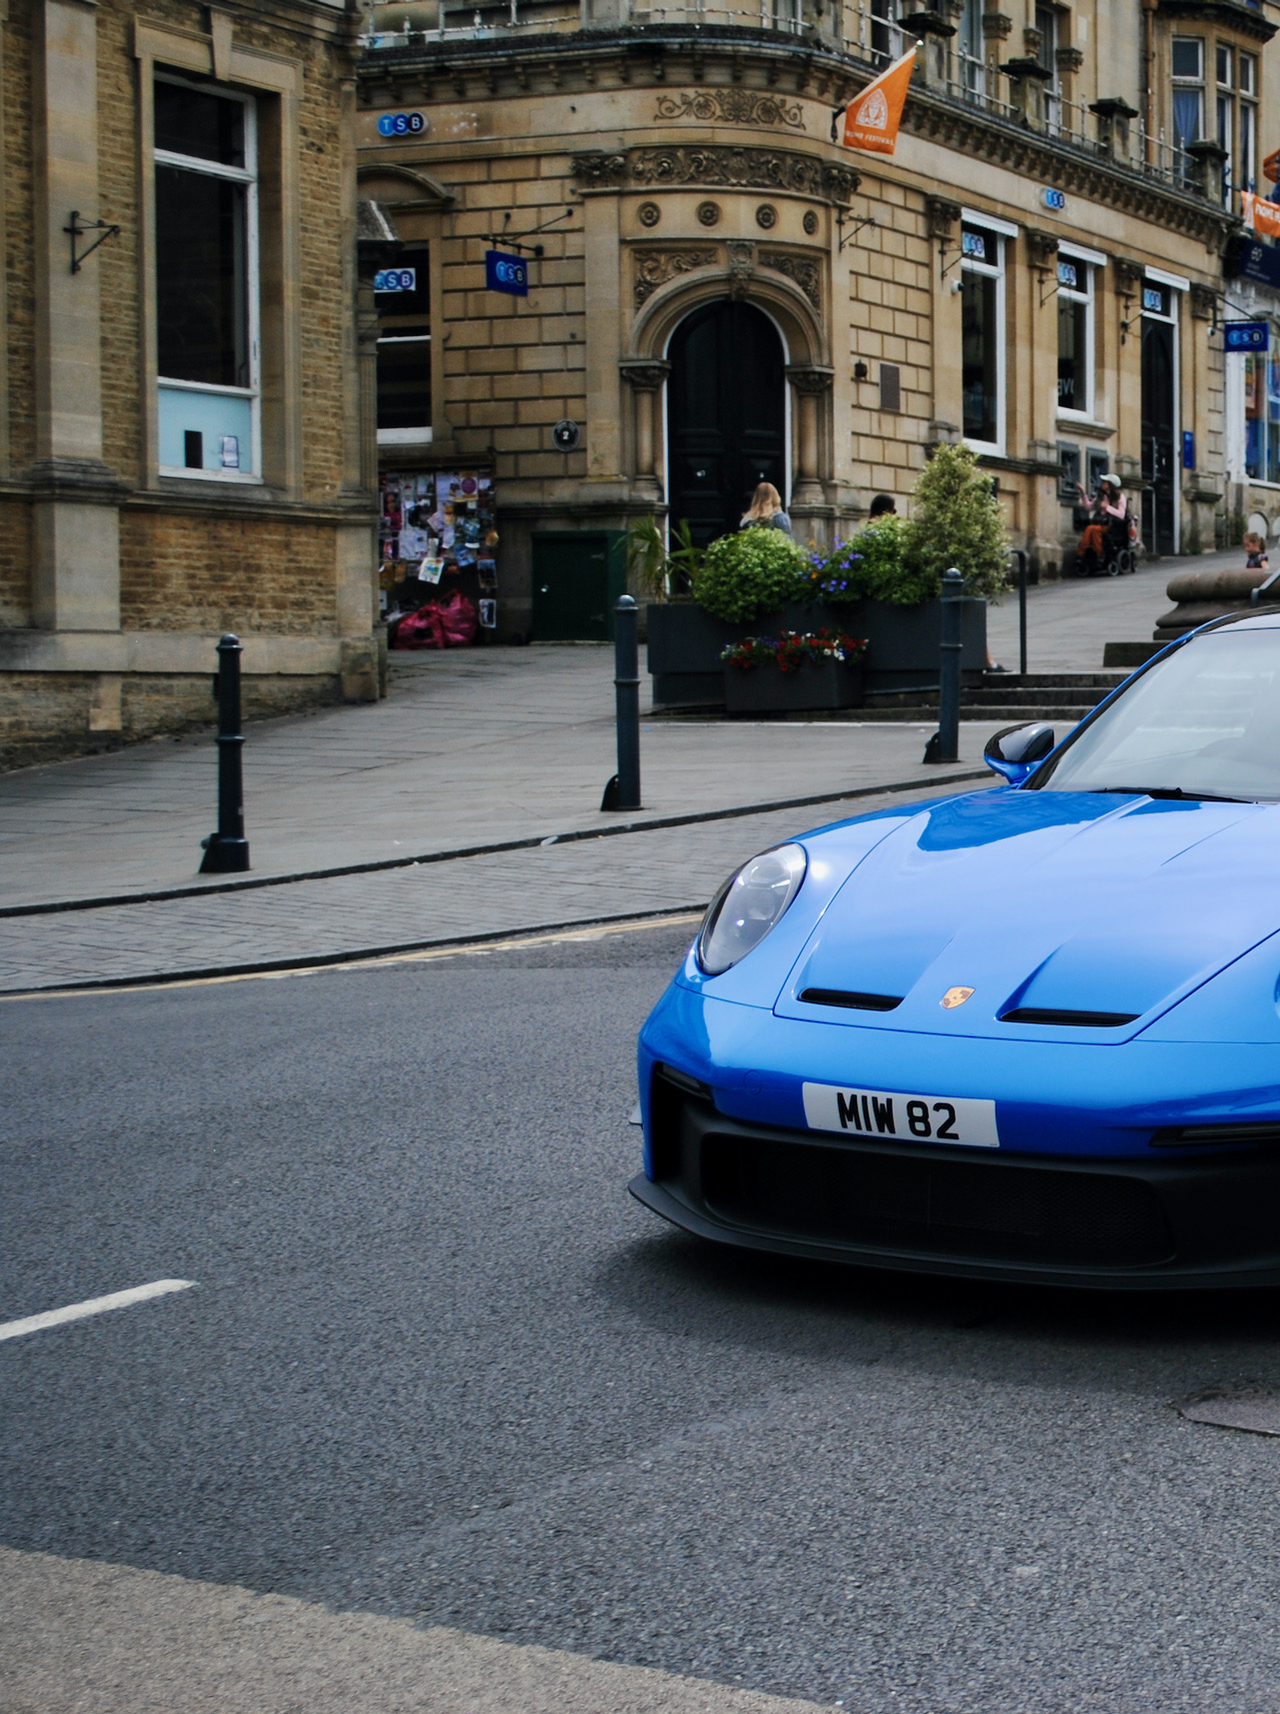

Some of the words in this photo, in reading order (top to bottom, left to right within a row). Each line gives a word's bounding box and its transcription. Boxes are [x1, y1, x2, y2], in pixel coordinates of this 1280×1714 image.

[381, 114, 422, 133] TSB
[1045, 189, 1065, 209] TSB
[375, 273, 412, 289] TSB
[498, 263, 525, 284] TSB
[1229, 331, 1263, 345] TSB
[836, 1091, 896, 1135] MIW
[905, 1099, 960, 1141] 82
